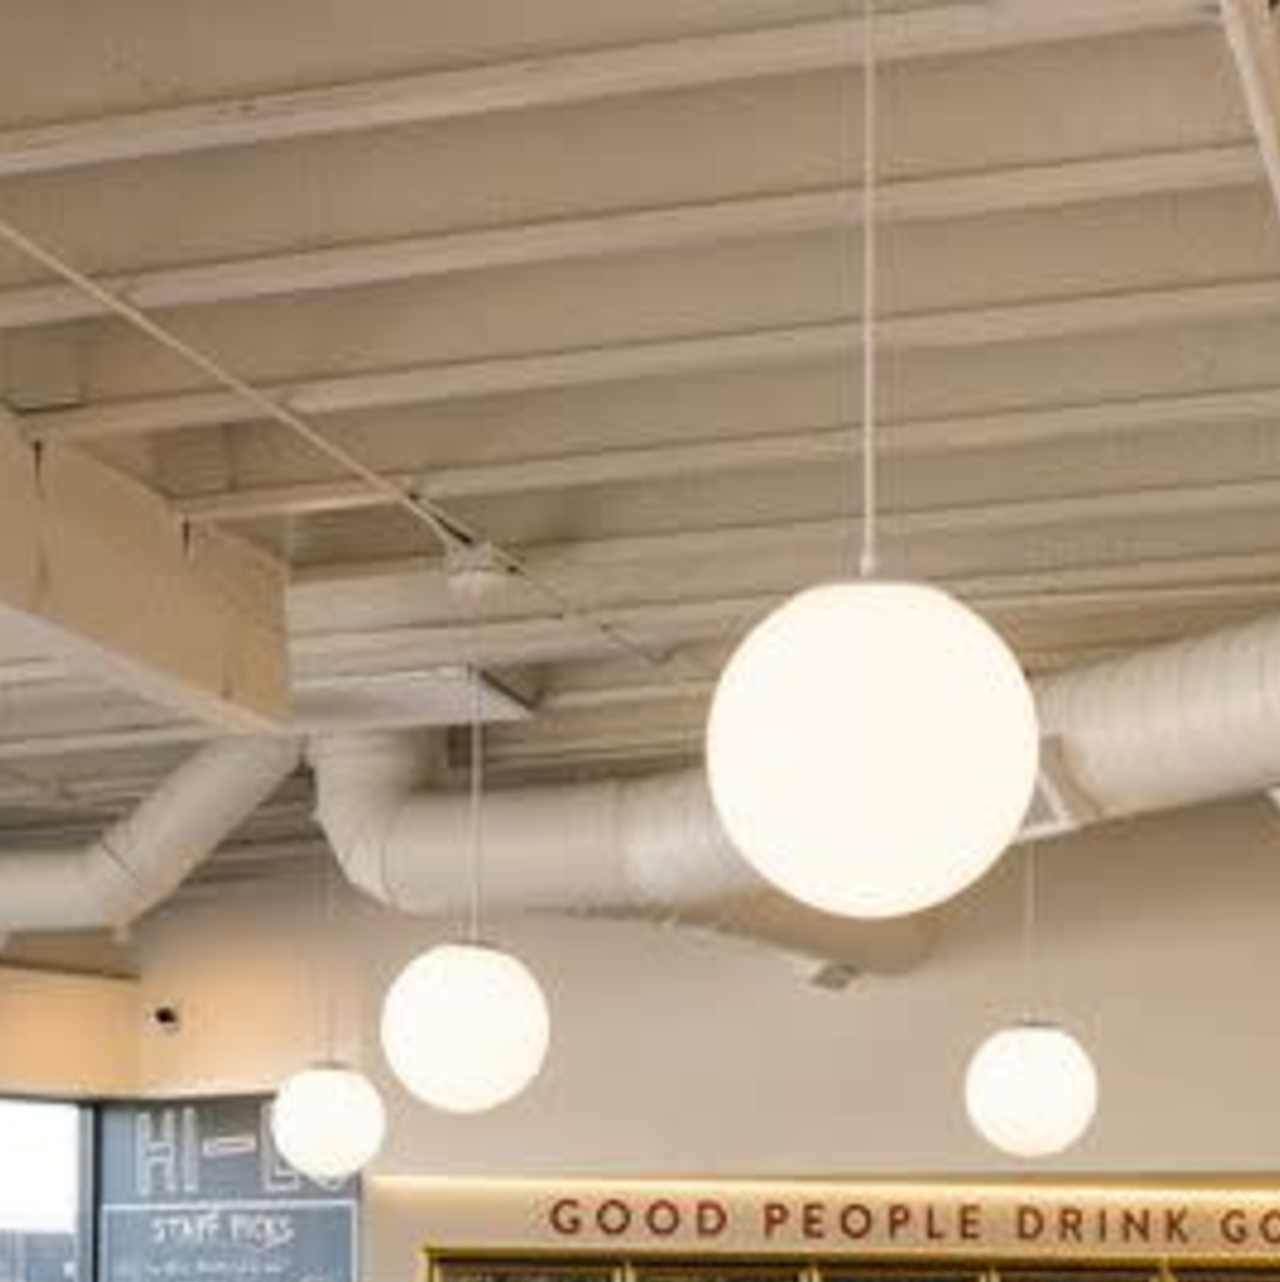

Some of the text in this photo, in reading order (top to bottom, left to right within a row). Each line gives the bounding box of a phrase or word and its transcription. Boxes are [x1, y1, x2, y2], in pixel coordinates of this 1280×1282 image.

[549, 1199, 728, 1236] GOOD
[763, 1203, 981, 1239] PEOPLE
[1017, 1205, 1190, 1243] DRINK
